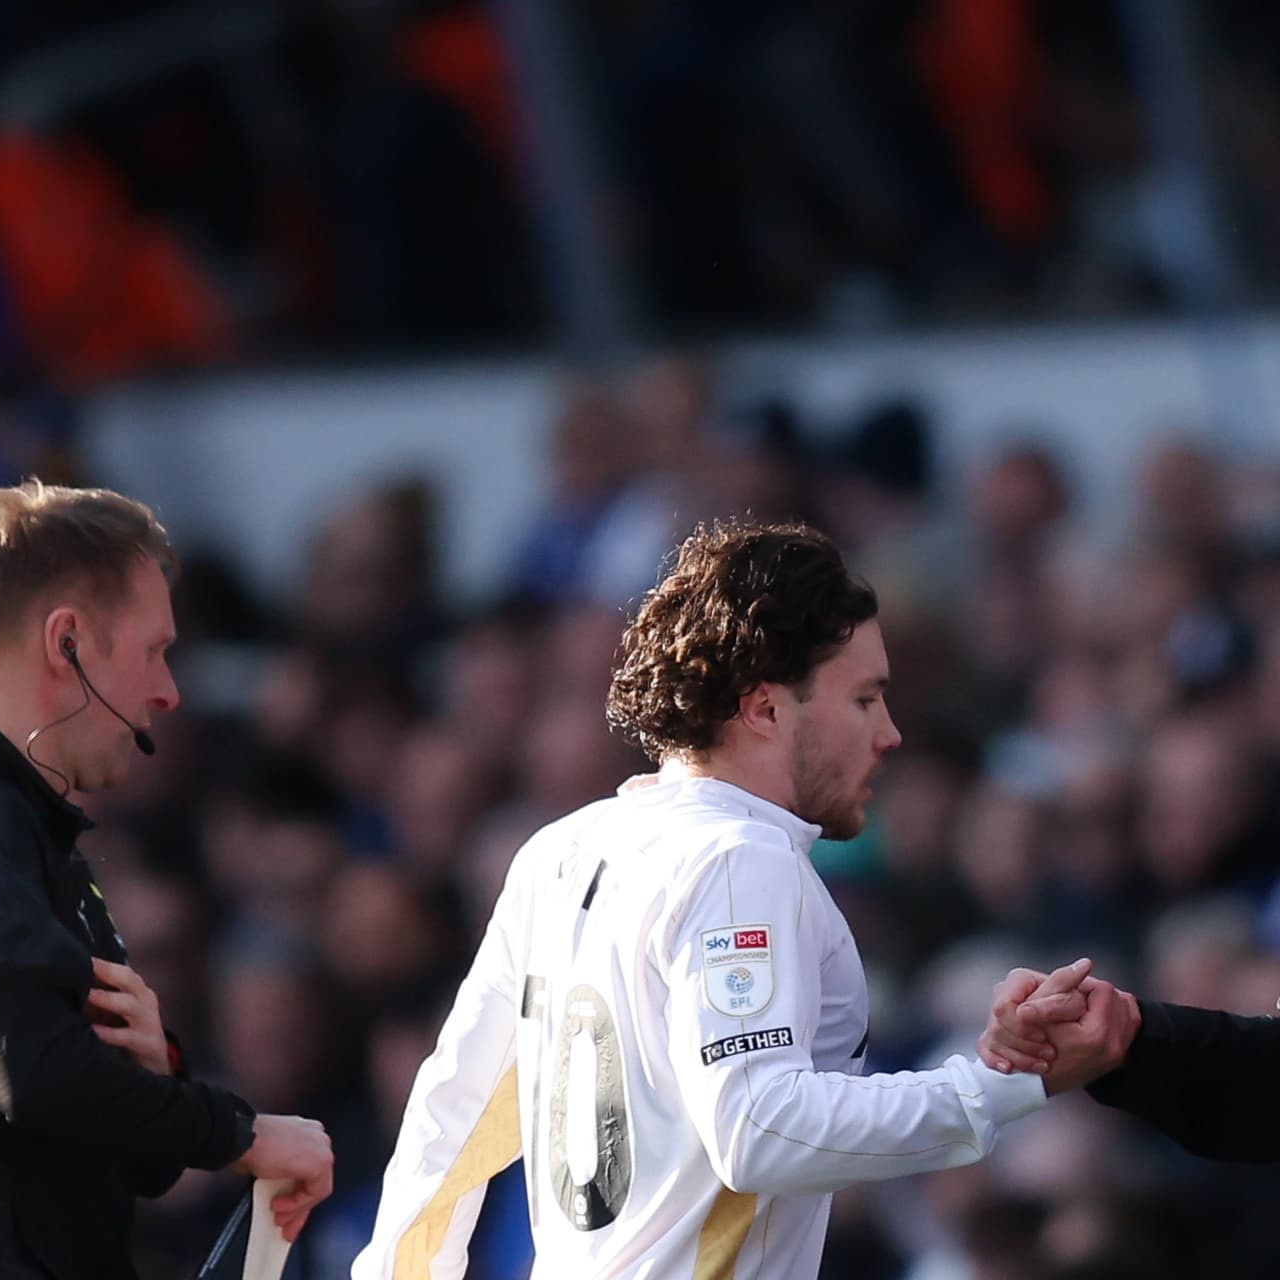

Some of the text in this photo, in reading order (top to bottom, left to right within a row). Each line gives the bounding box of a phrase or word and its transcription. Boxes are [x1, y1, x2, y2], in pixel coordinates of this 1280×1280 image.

[706, 933, 765, 950] sky bet
[707, 951, 769, 965] CHAMPIONSHIP
[729, 996, 753, 1010] EFL
